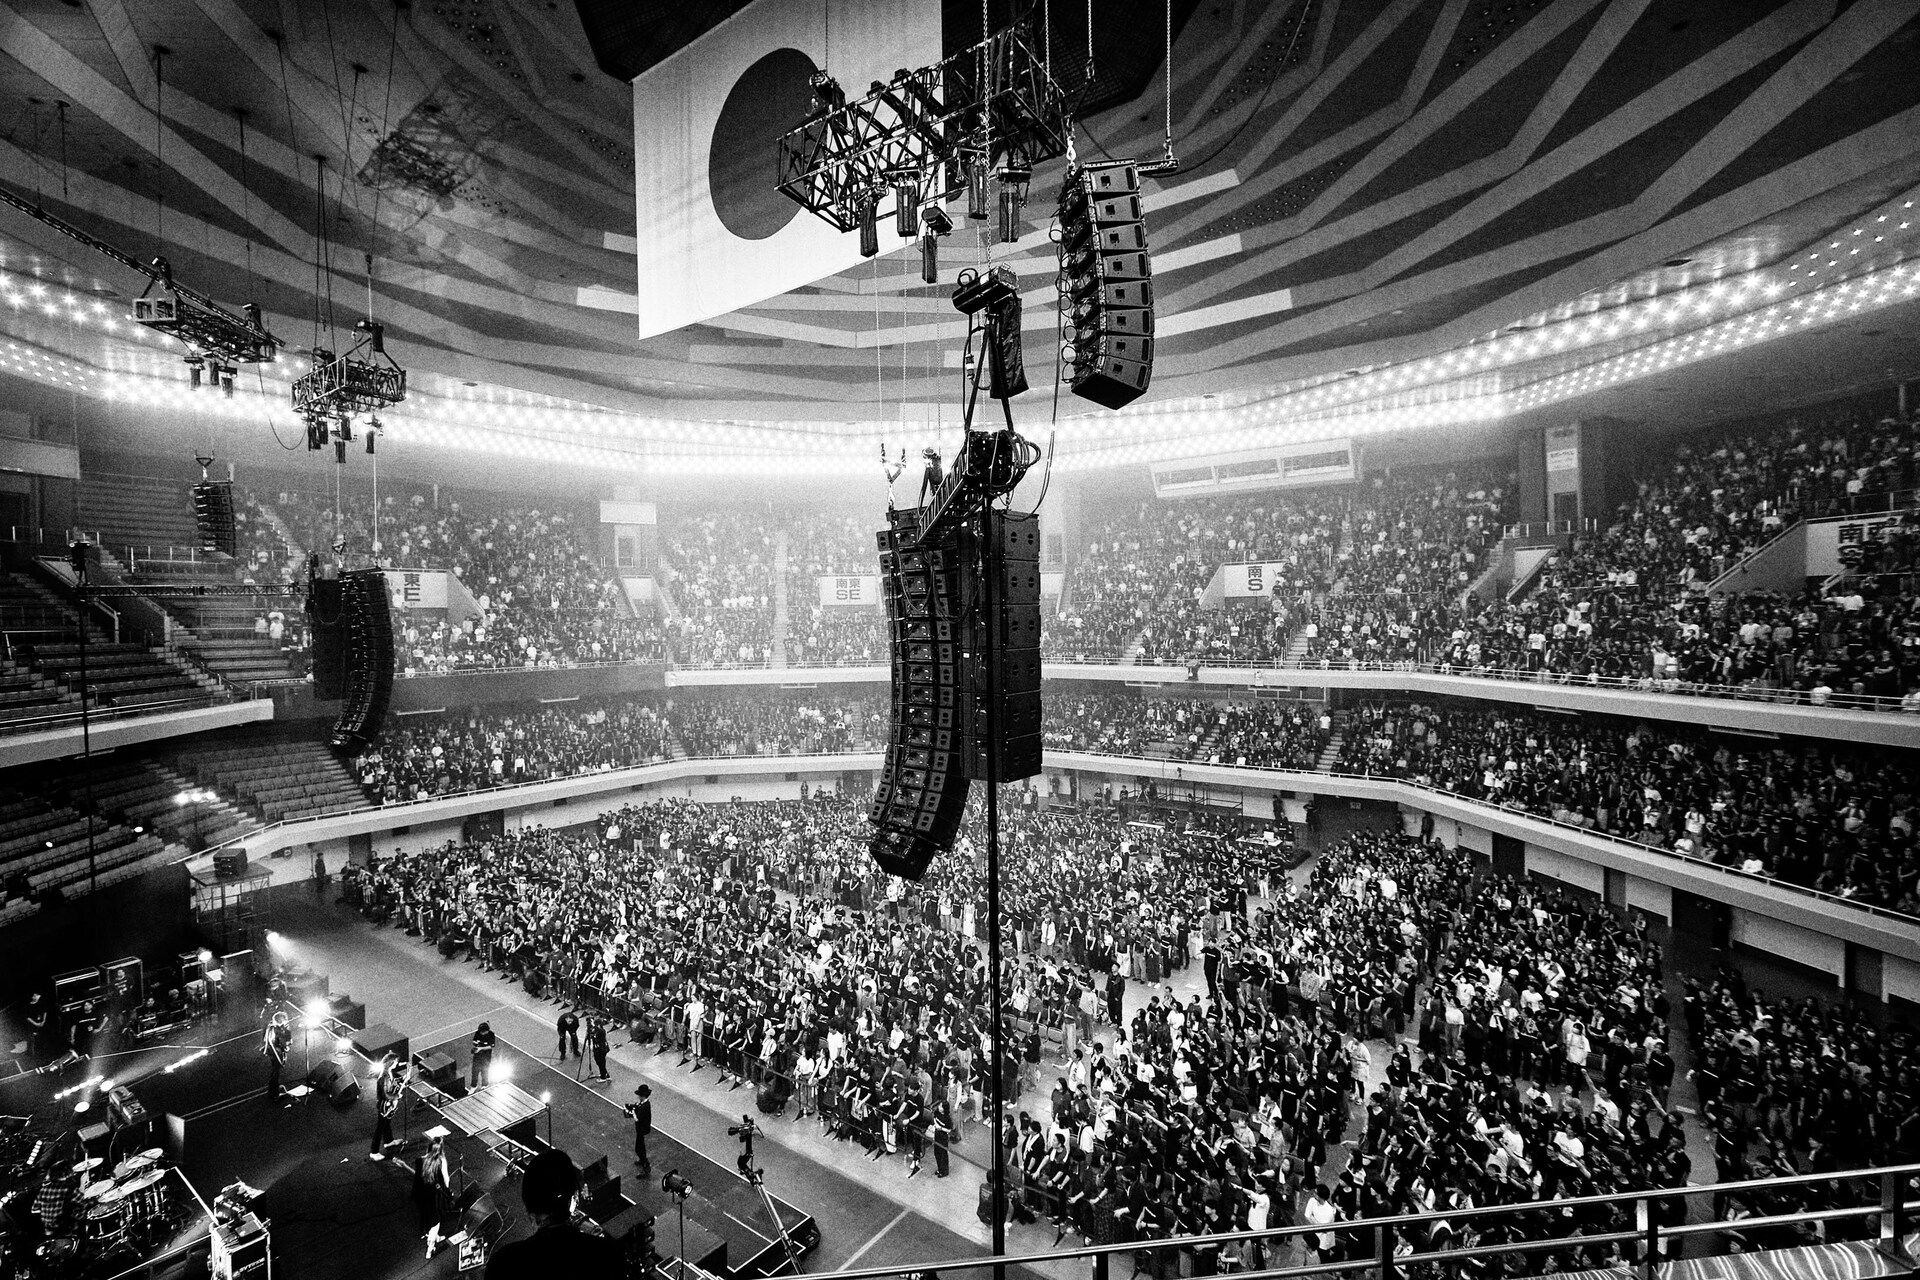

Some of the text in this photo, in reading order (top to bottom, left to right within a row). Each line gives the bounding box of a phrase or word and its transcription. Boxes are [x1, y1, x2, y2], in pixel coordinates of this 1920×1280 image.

[1248, 565, 1262, 578] 南
[404, 573, 420, 586] 東
[836, 578, 860, 588] 南東
[1248, 579, 1263, 591] S
[404, 588, 420, 601] E
[836, 590, 860, 600] SE
